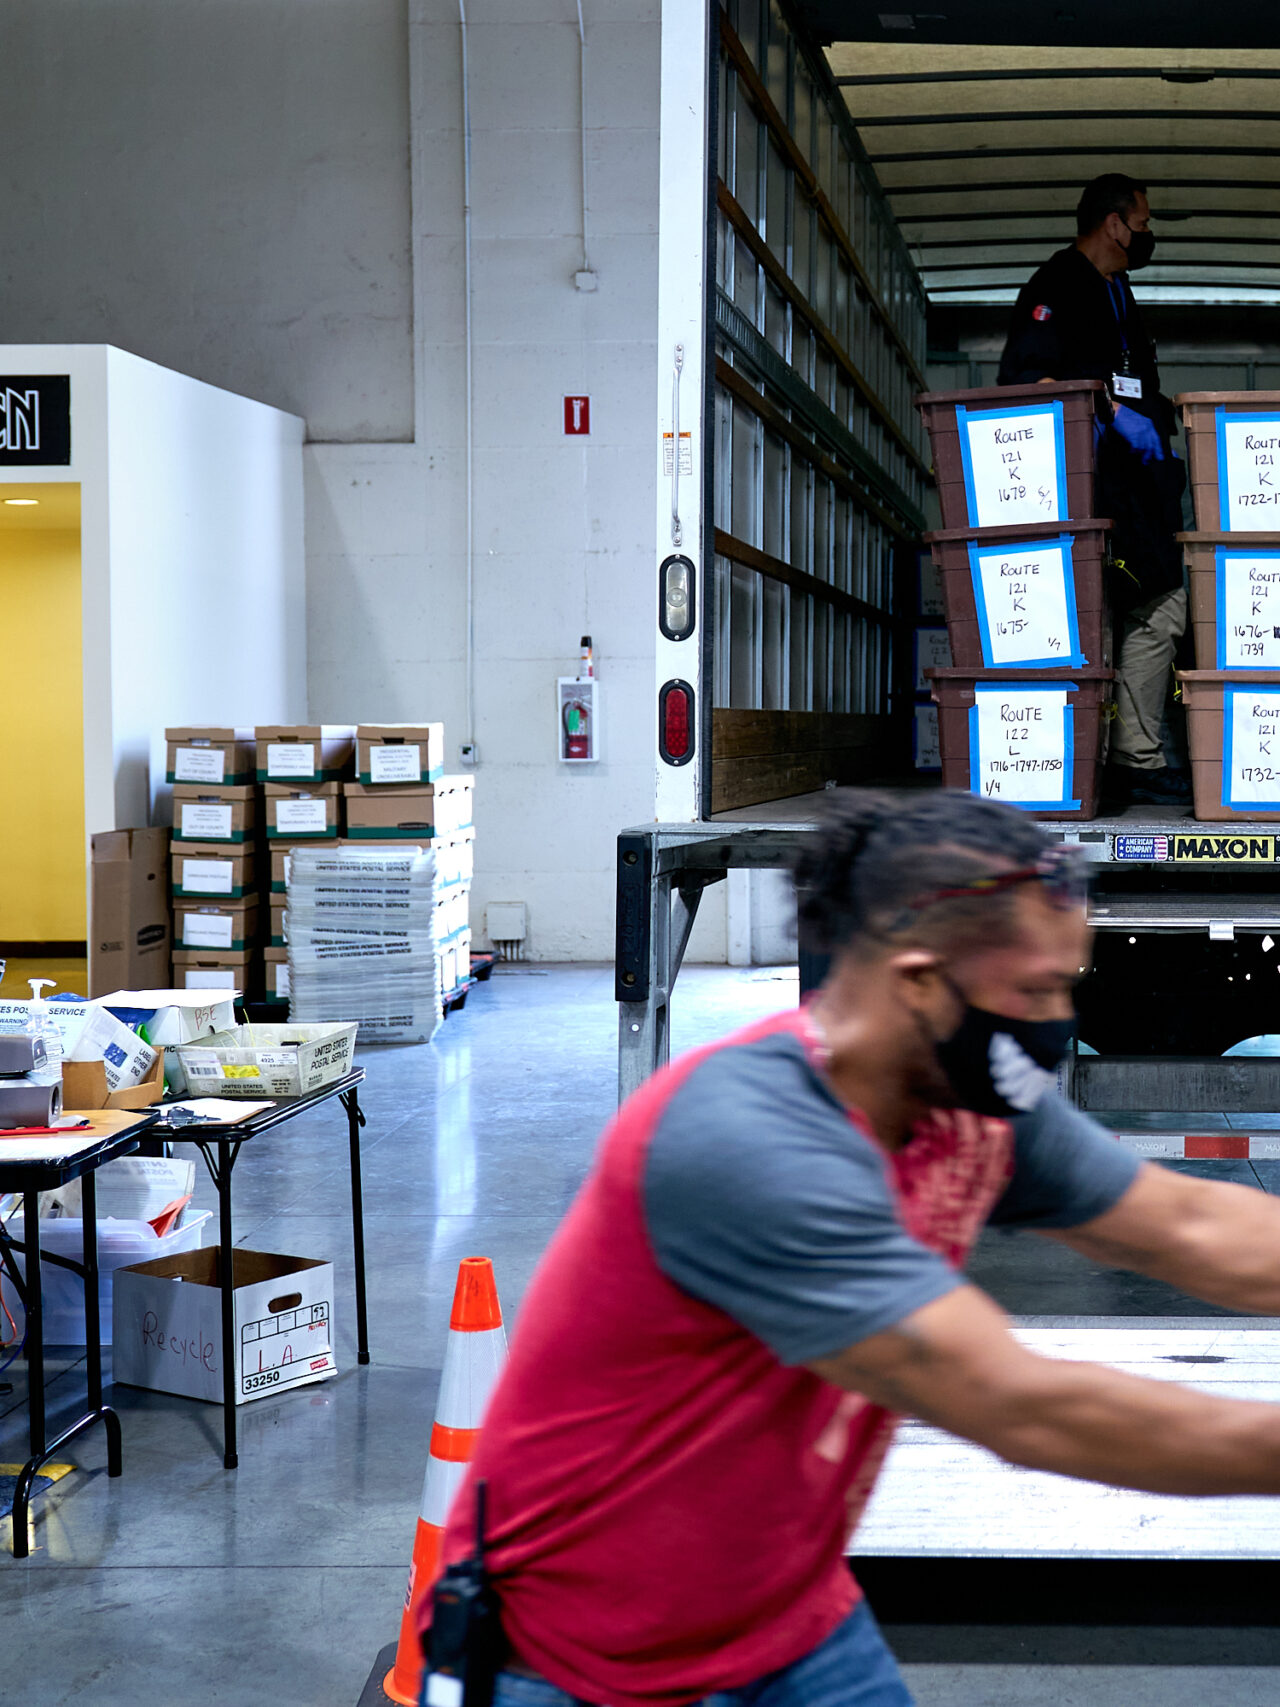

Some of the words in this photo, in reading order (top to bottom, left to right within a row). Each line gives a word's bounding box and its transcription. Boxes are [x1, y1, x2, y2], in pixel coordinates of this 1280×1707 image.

[994, 428, 1034, 444] ROUTE
[1002, 451, 1022, 463] 121
[1255, 454, 1274, 466] 121
[1009, 467, 1021, 480] K
[1258, 471, 1273, 486] K
[999, 486, 1026, 502] 1678
[1000, 563, 1040, 577] ROUTE
[1009, 582, 1027, 595] 121
[1251, 585, 1268, 597] 121
[1013, 597, 1026, 611] K
[1252, 601, 1262, 616] K
[1240, 642, 1264, 656] 1739
[1000, 704, 1043, 722] ROUTE
[1006, 728, 1029, 740] 122
[1258, 724, 1276, 735] 121
[1009, 745, 1020, 756] L
[1259, 740, 1271, 755] K
[985, 779, 1001, 796] 1/4
[1176, 838, 1269, 859] MAXON
[49, 1007, 86, 1016] SERVICE
[315, 1043, 331, 1057] UNITED
[311, 1056, 329, 1070] POSTAL
[143, 1311, 218, 1373] Recycle
[245, 1371, 280, 1390] 33250
